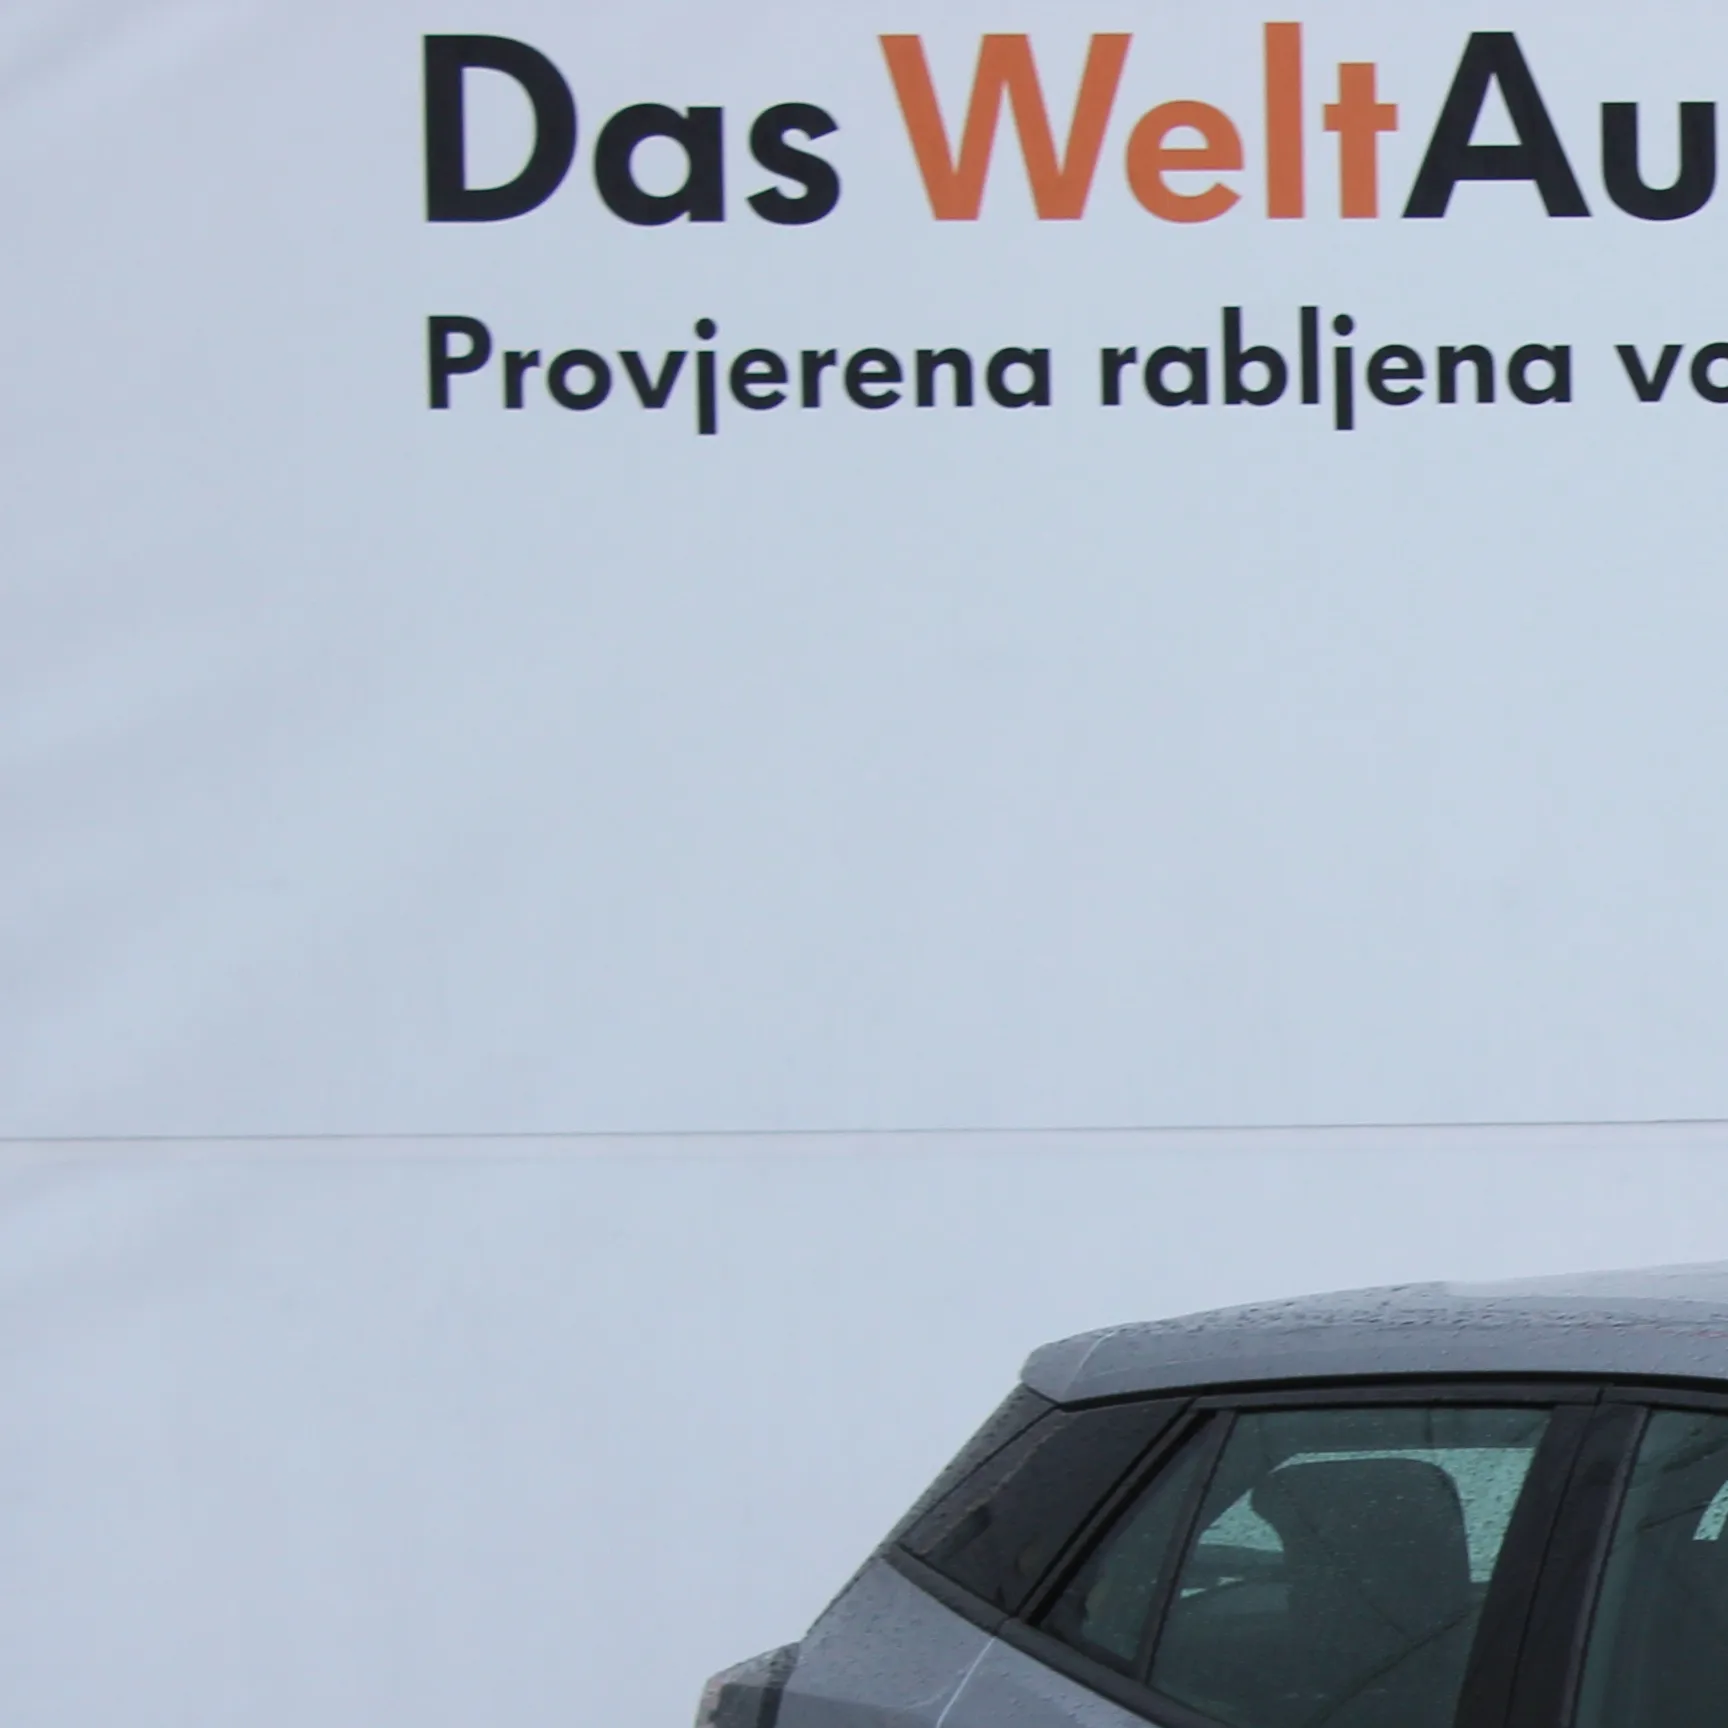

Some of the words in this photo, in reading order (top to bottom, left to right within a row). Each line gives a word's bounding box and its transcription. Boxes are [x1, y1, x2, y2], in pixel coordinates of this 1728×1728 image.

[423, 32, 841, 227] Das
[427, 314, 1051, 436] Provjerena
[1101, 305, 1573, 431] rabljena
